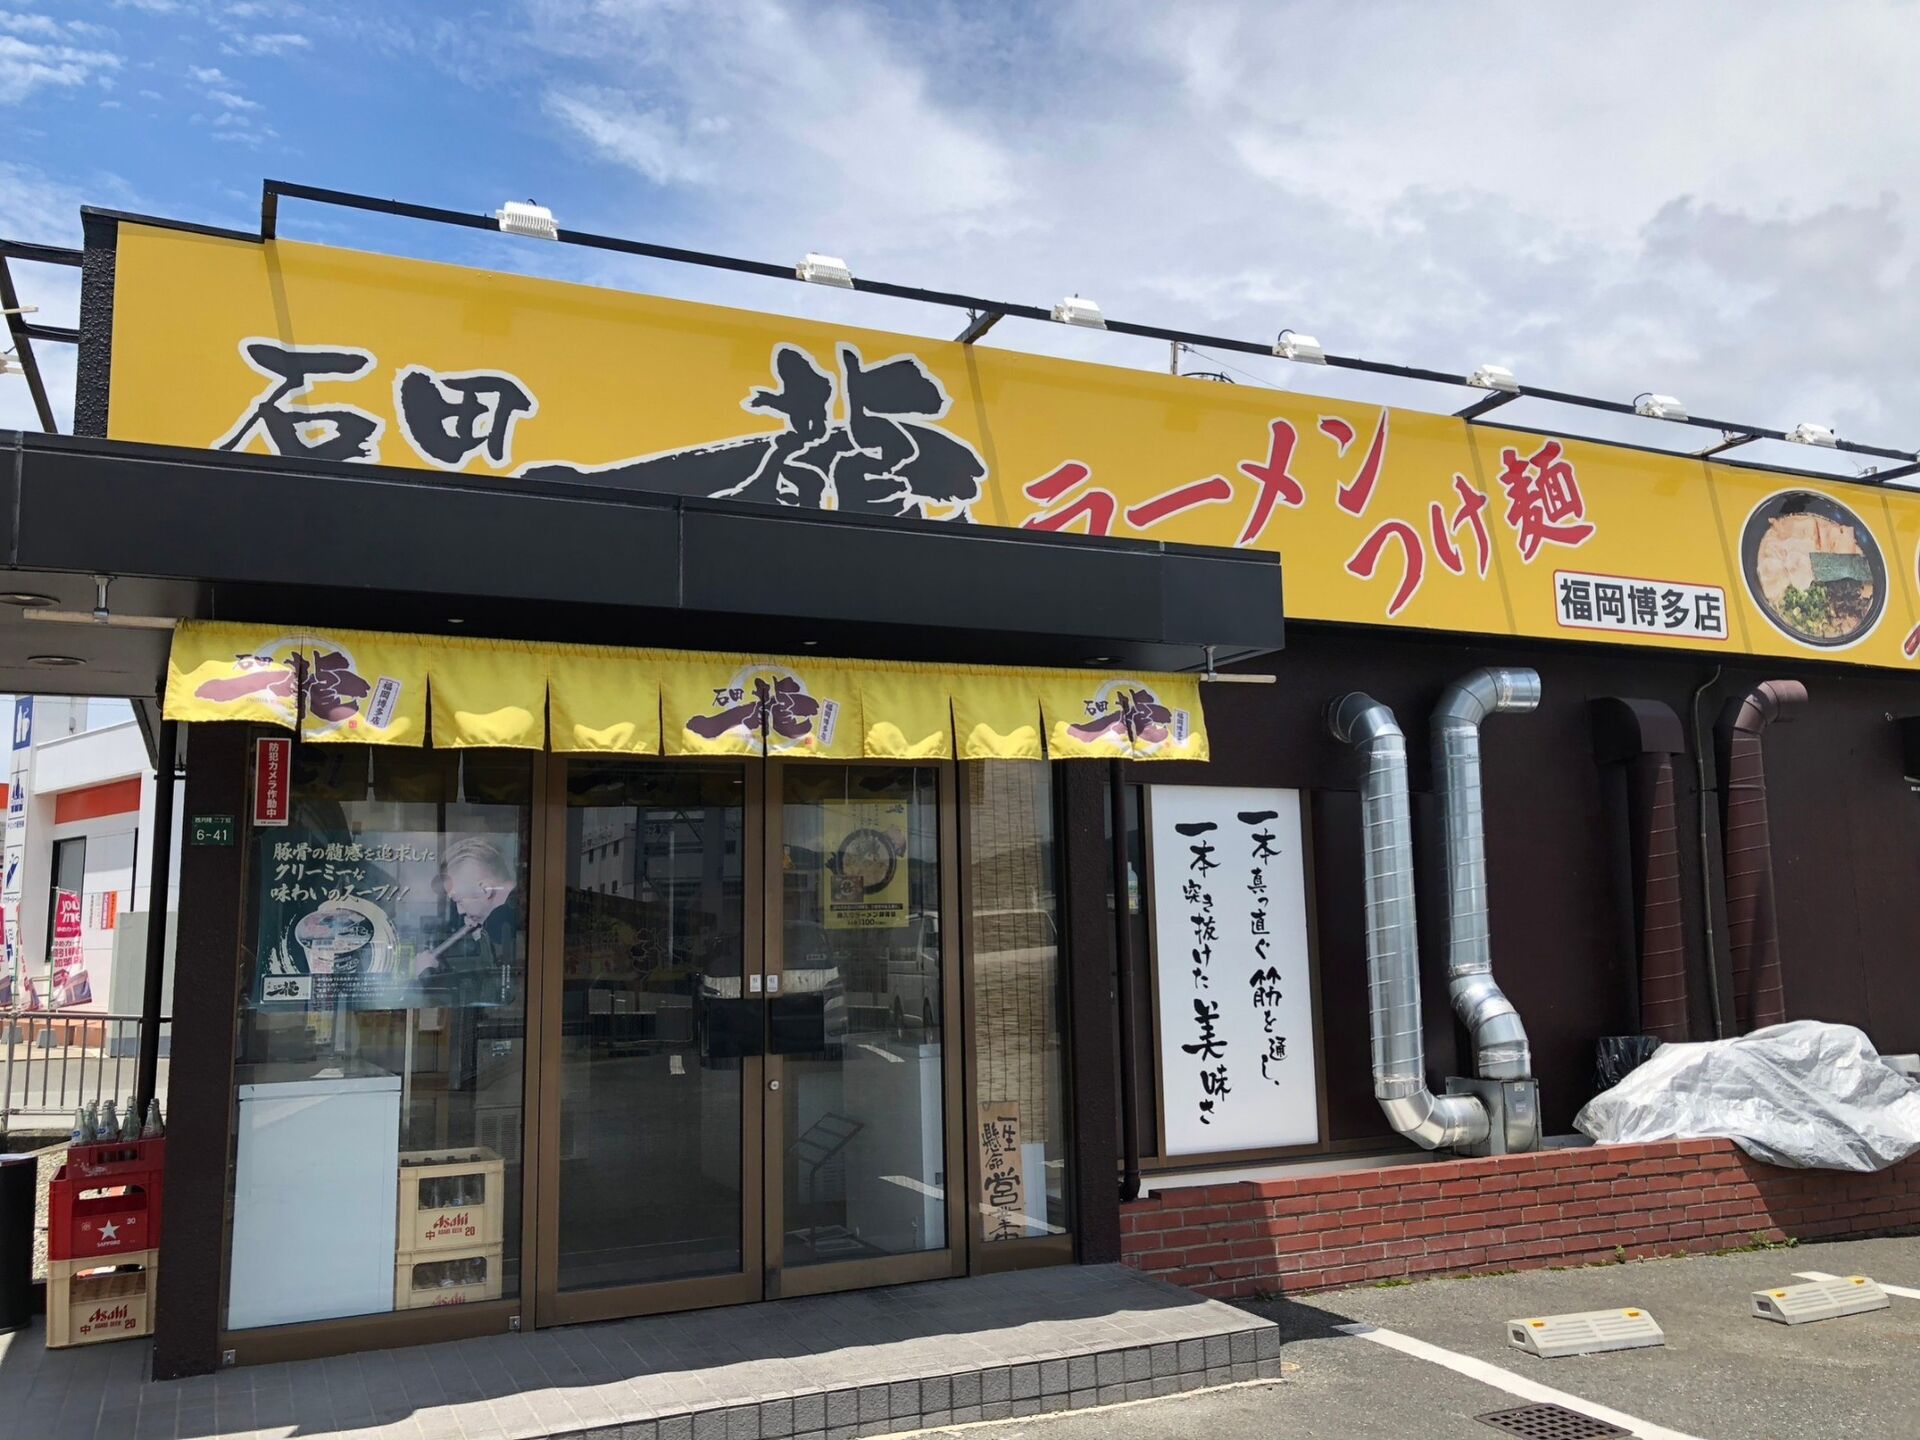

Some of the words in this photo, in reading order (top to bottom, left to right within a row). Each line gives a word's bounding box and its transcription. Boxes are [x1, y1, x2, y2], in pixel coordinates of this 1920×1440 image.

[213, 336, 539, 470] 石田
[1020, 404, 1392, 548] ラーメン
[1345, 437, 1598, 618] つけ麺
[1559, 577, 1724, 634] 福岡博多店
[371, 681, 394, 727] 福岡博多店
[712, 687, 745, 707] 石田
[266, 742, 280, 818] 防犯カメラ作動中
[196, 829, 227, 841] 6-41
[273, 863, 367, 881] クリーミーな
[1174, 821, 1233, 1125] 一本突き抜けた美味さ
[425, 1230, 436, 1240] 中
[464, 1226, 476, 1237] 20
[433, 1213, 469, 1229] Asahi
[79, 1324, 91, 1335] 中
[124, 1318, 136, 1329] 20
[89, 1304, 128, 1323] Asahi
